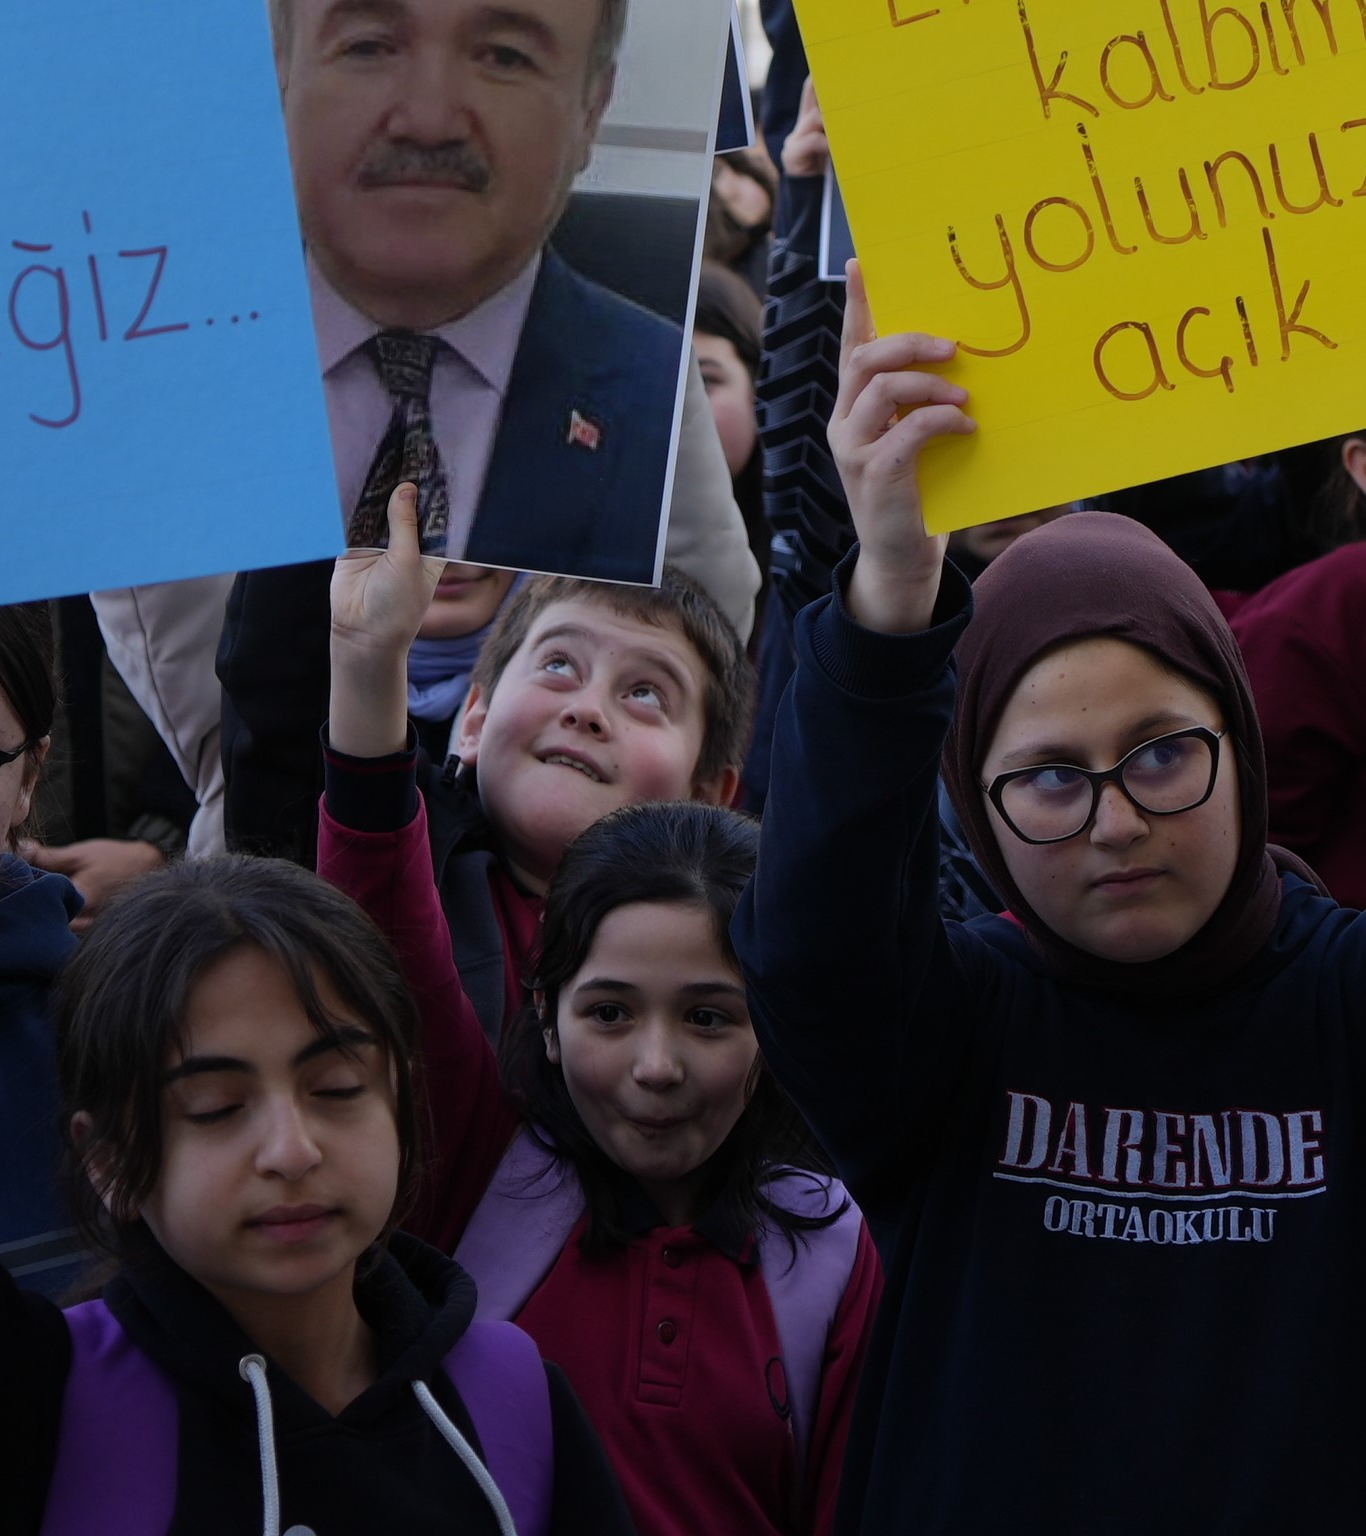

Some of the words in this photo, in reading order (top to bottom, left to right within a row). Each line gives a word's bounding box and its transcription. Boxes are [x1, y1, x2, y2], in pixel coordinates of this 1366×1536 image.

[1092, 226, 1338, 402] açık
[998, 1089, 1326, 1188] DARENDE
[1043, 1196, 1278, 1244] ORTAOKULU
